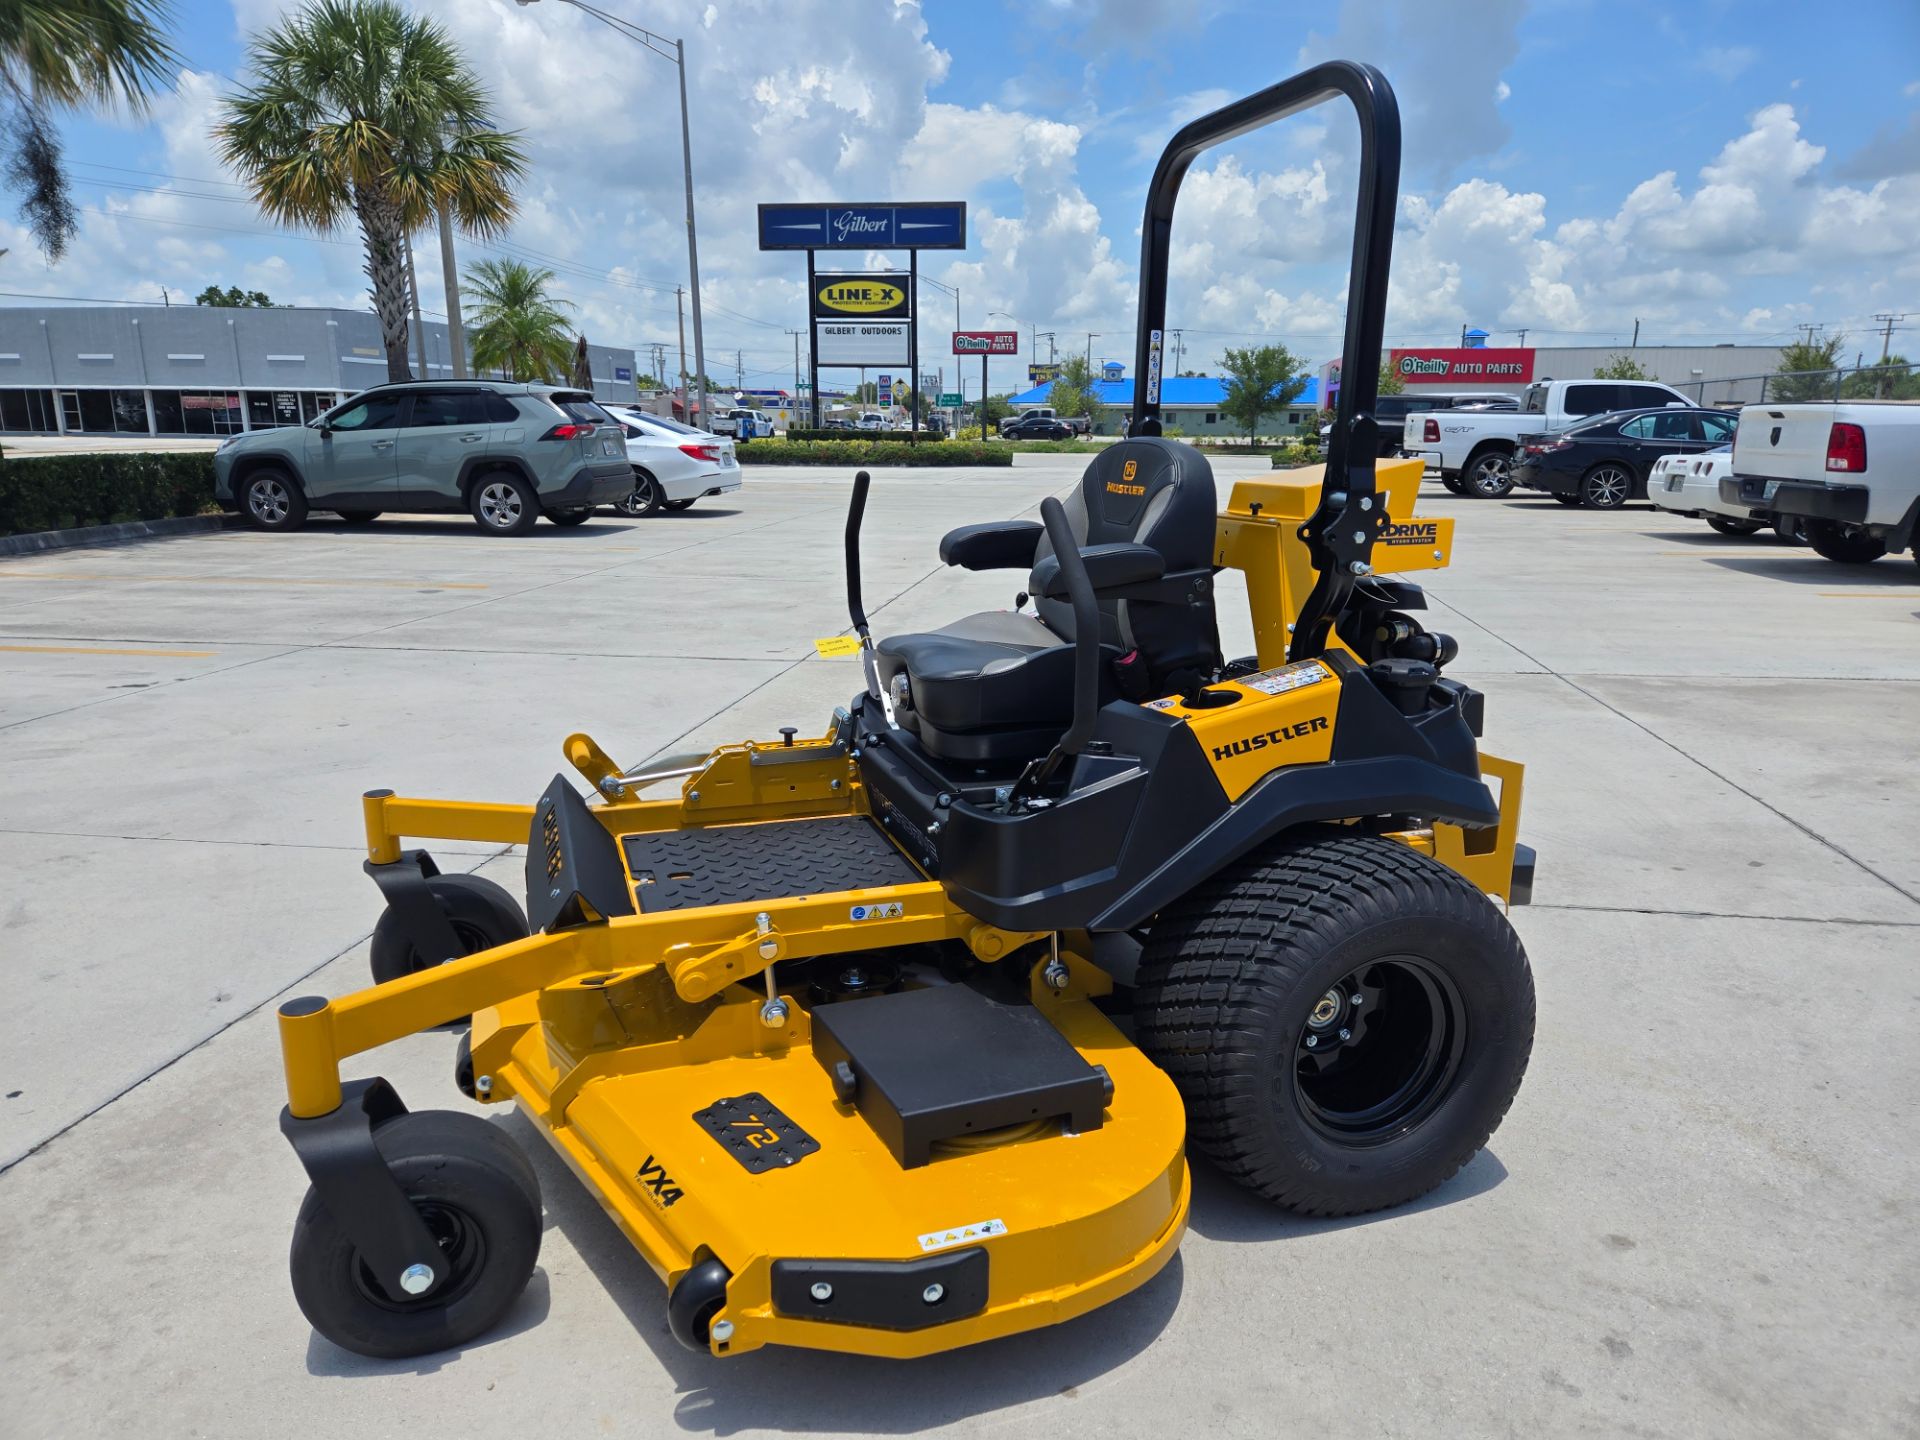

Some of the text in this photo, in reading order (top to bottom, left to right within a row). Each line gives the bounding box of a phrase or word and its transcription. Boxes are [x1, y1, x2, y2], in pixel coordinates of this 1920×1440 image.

[833, 211, 888, 241] Gilbert
[825, 327, 902, 335] GILBERT OUTDOORS
[994, 335, 1013, 343] AUTO
[956, 335, 991, 350] O'Reilly
[992, 343, 1015, 351] PARTS
[1401, 357, 1523, 375] O'Reilly AUTO PARTS
[1106, 481, 1146, 496] HUSTLER
[1212, 716, 1329, 761] HUSTLER
[729, 1113, 780, 1149] 72
[638, 1154, 685, 1208] VX4
